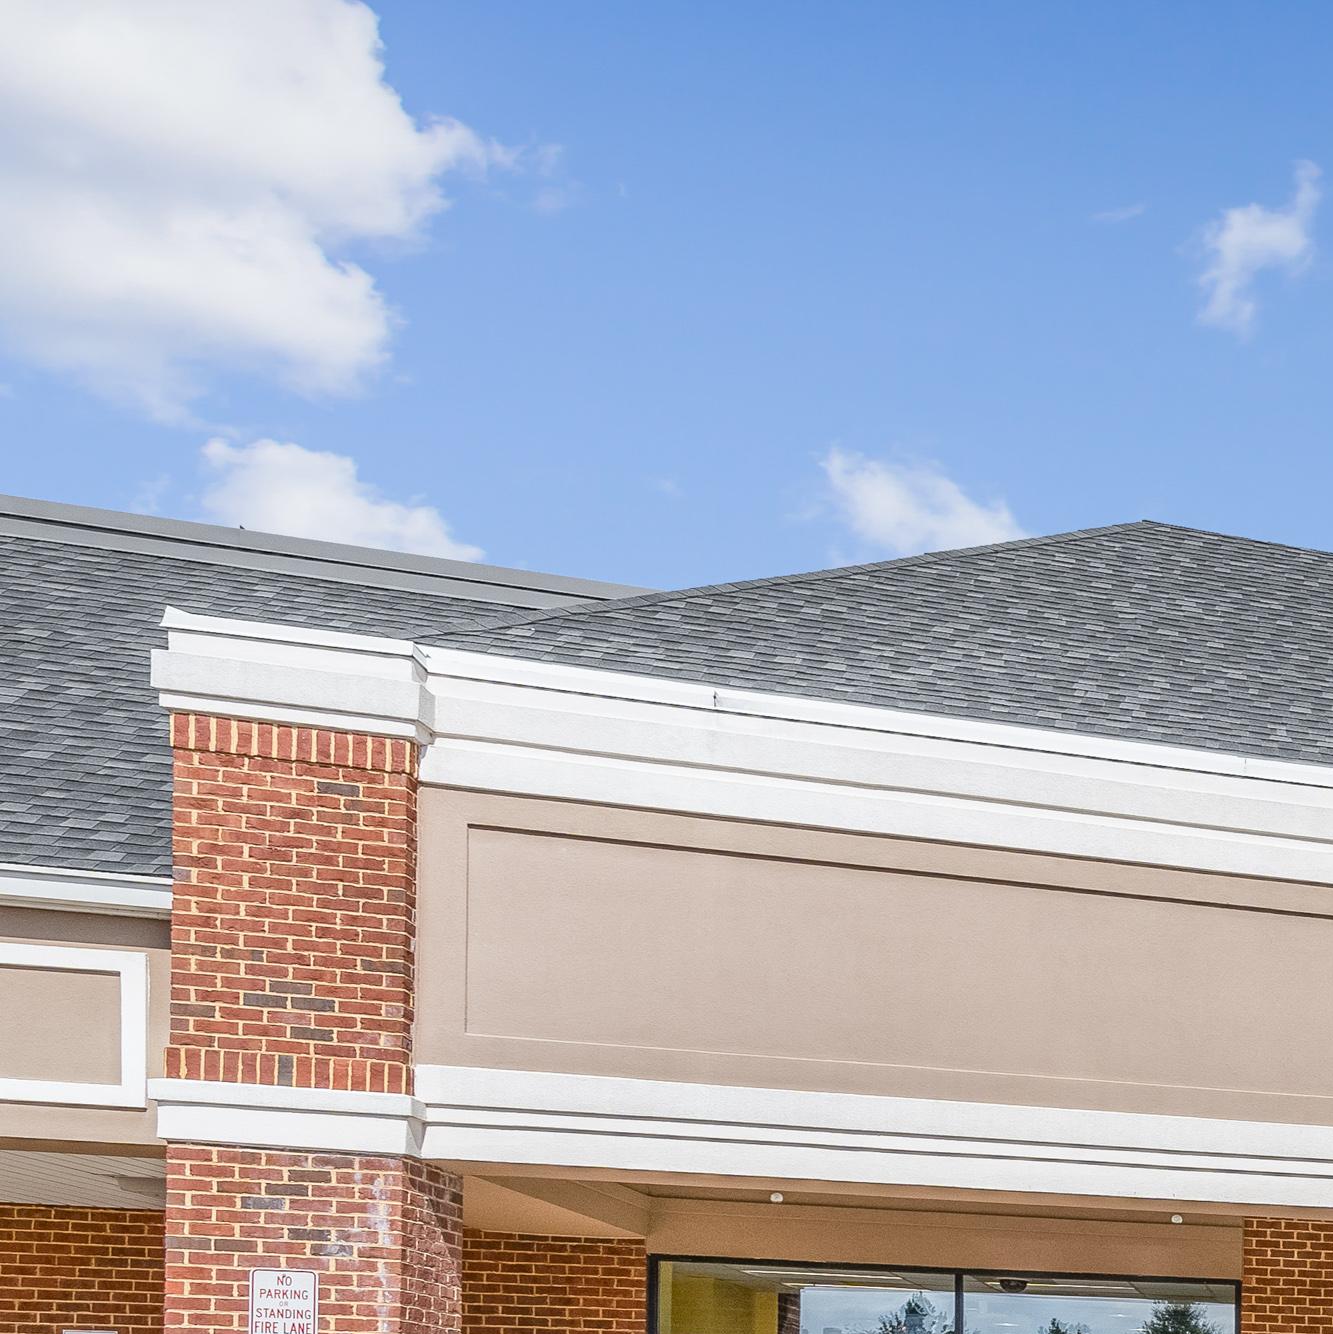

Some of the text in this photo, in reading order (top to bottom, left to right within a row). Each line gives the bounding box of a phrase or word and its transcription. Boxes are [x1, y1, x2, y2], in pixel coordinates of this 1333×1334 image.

[277, 1276, 292, 1286] NO
[259, 1289, 308, 1300] PARKING
[256, 1307, 311, 1319] STANDING
[254, 1321, 312, 1334] FIRE LANE
